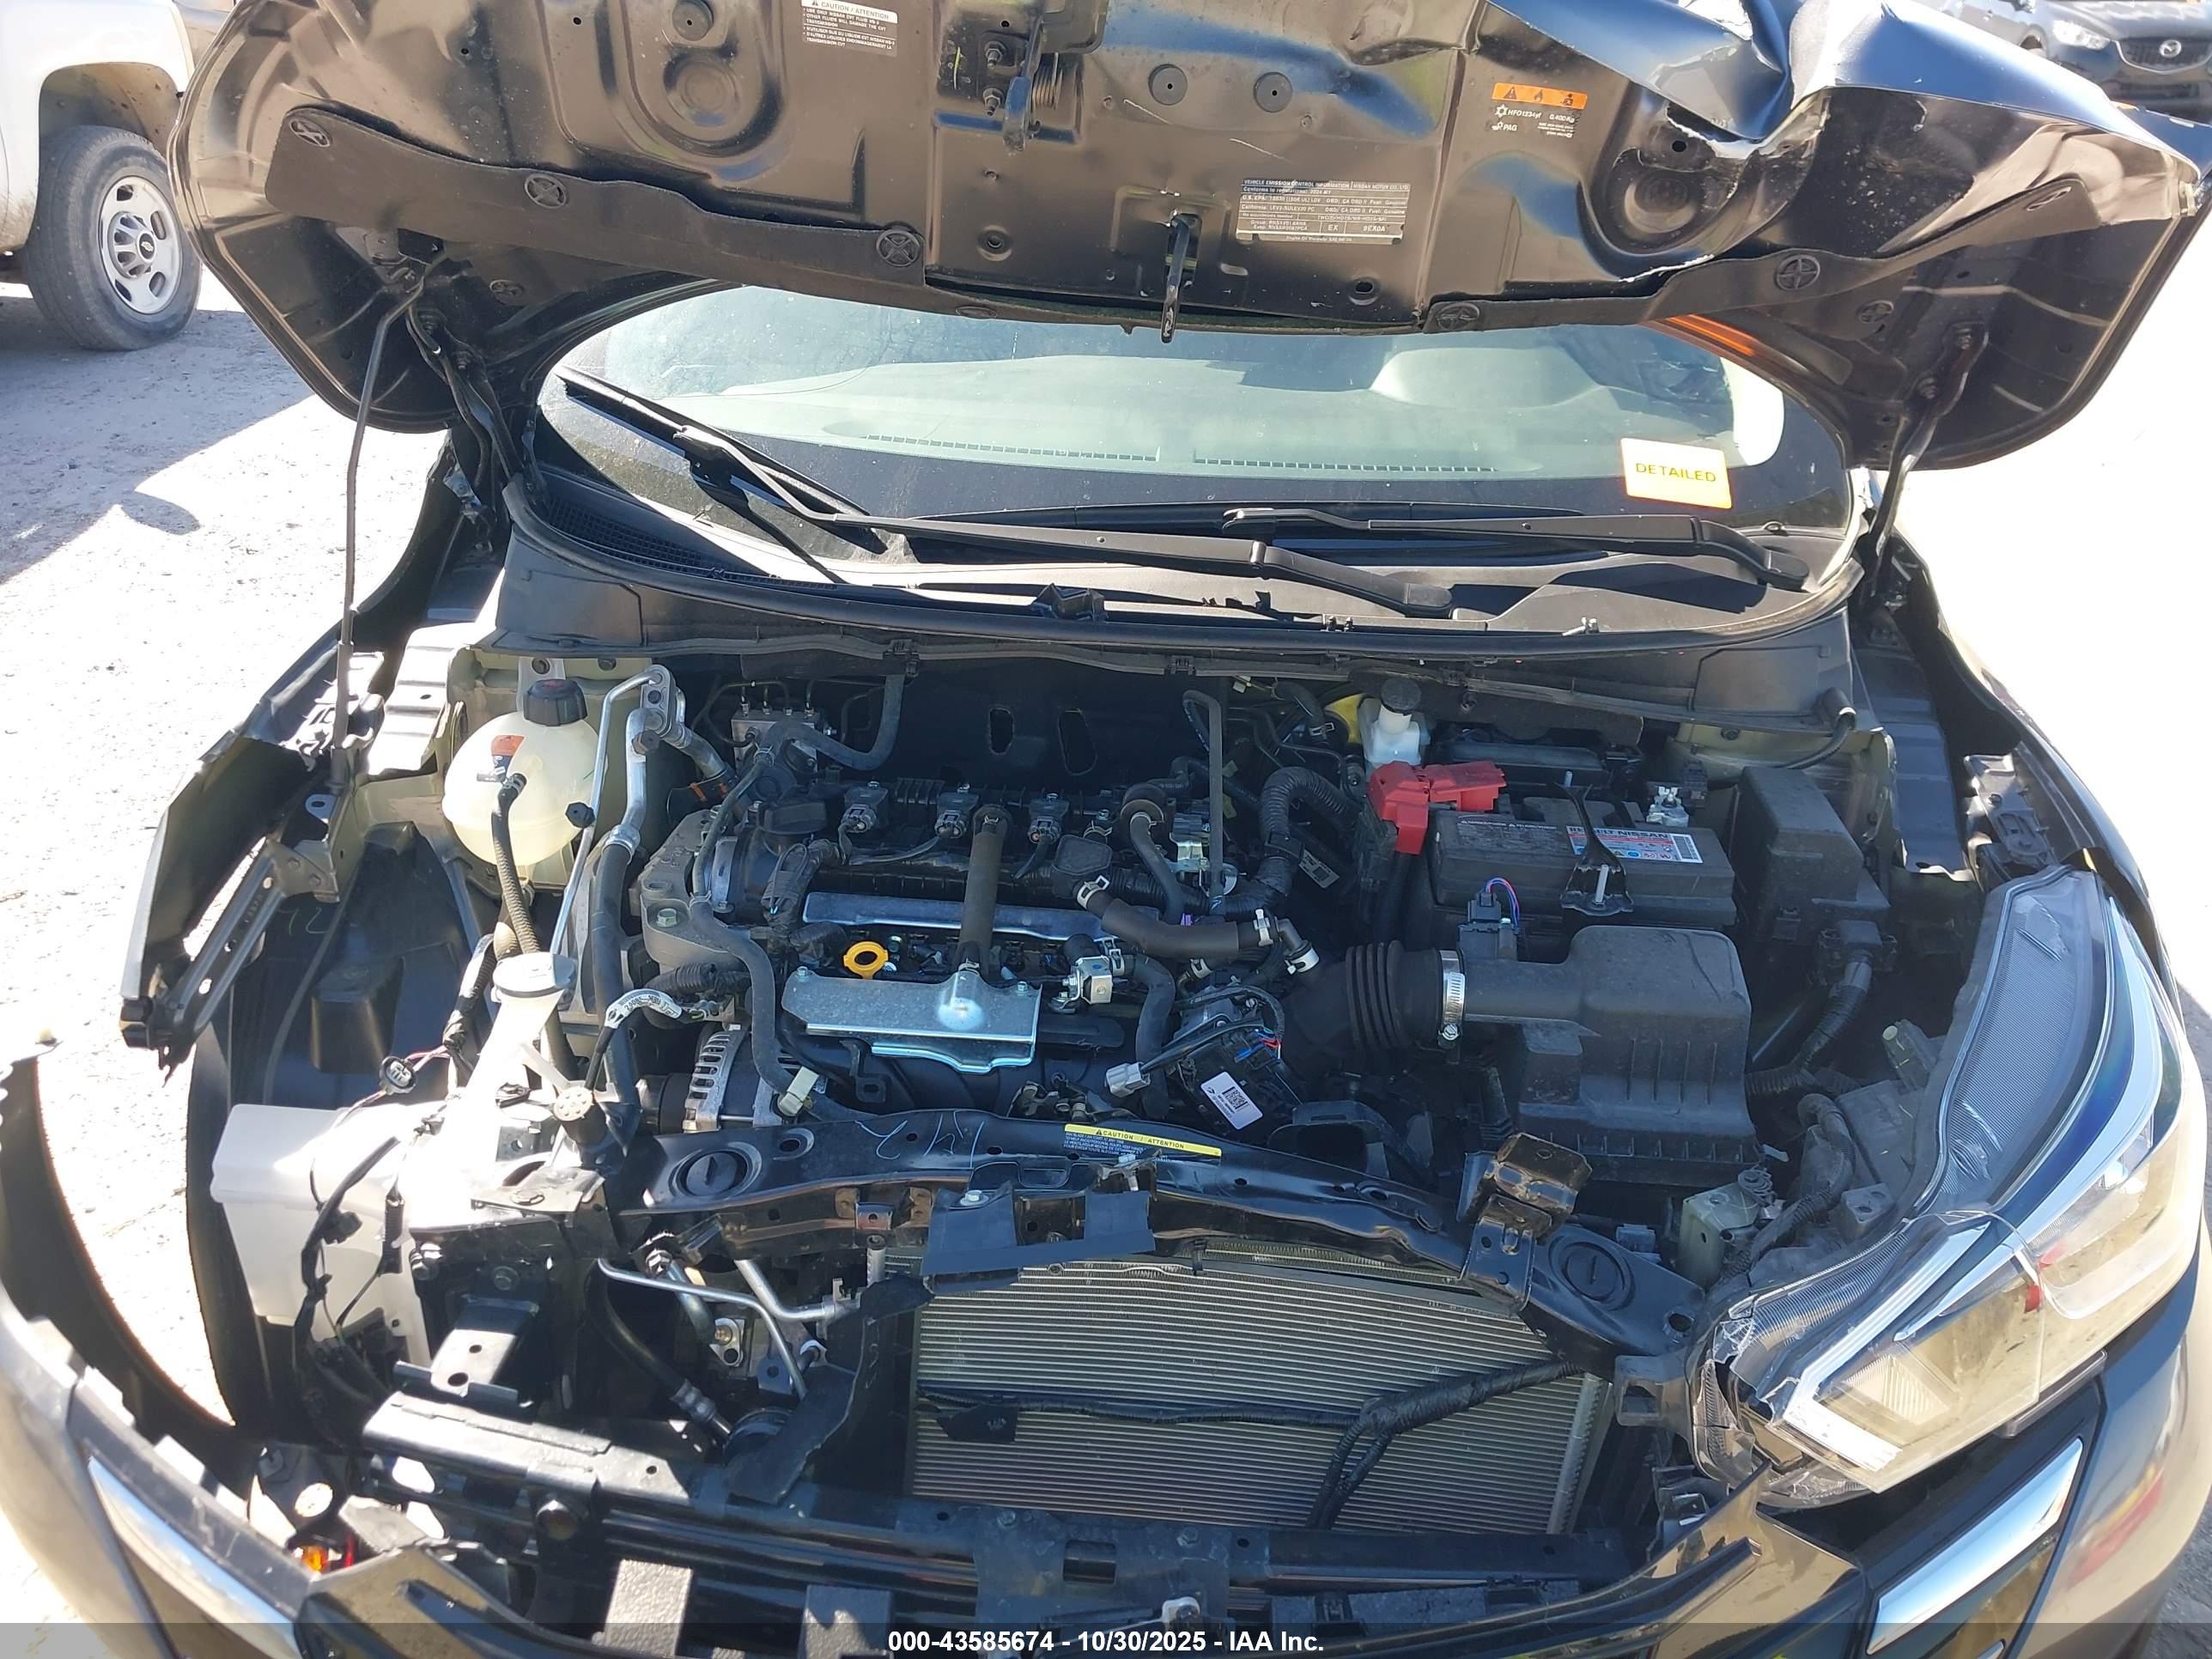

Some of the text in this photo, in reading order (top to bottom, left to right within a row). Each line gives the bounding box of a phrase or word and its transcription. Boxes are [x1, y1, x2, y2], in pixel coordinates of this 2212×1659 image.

[821, 1, 849, 12] CAUTION
[855, 6, 889, 19] ATTENTION
[1635, 463, 1716, 482] DETAILED
[1616, 830, 1669, 839] NISSAN
[1103, 1130, 1134, 1141] CAUTION
[1147, 1138, 1184, 1149] ATTENTION
